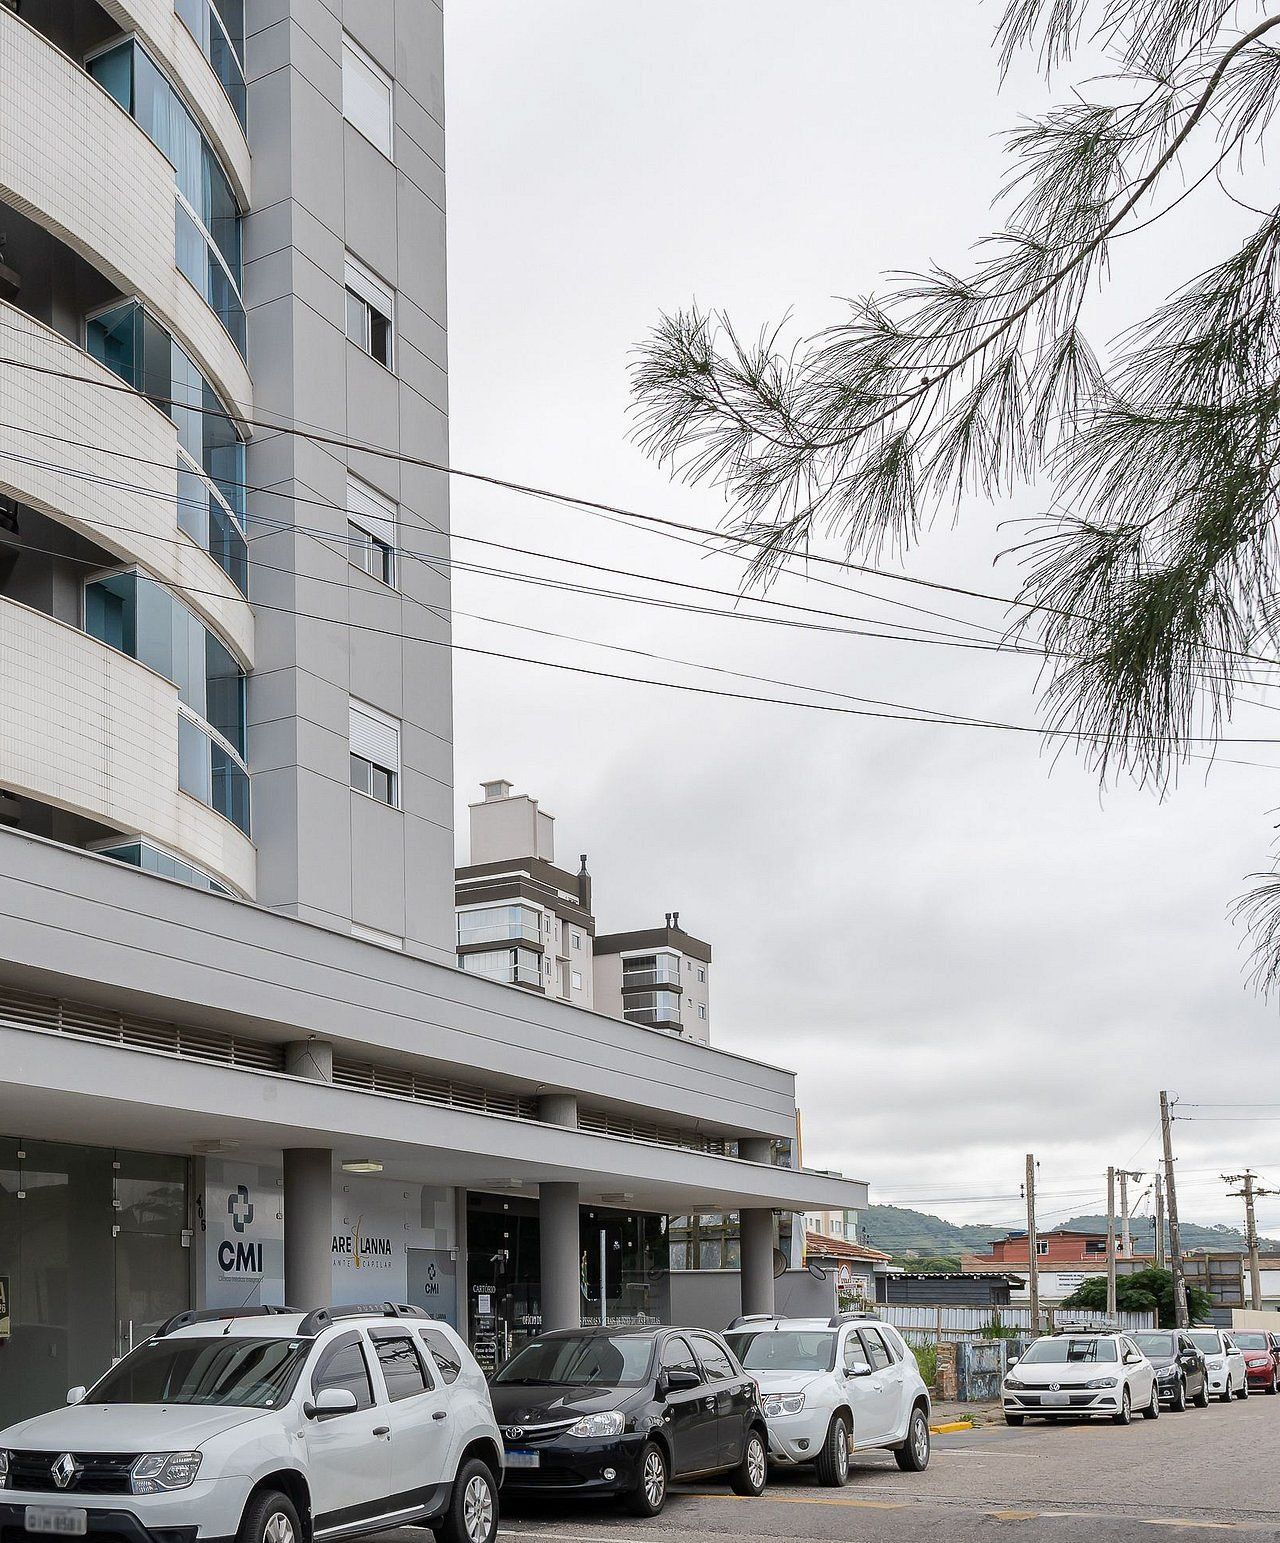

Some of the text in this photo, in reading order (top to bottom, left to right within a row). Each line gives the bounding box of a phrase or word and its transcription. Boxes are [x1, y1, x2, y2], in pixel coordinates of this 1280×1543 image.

[360, 1238, 392, 1255] LANNA
[218, 1240, 263, 1272] CMI
[425, 1283, 439, 1294] CMI
